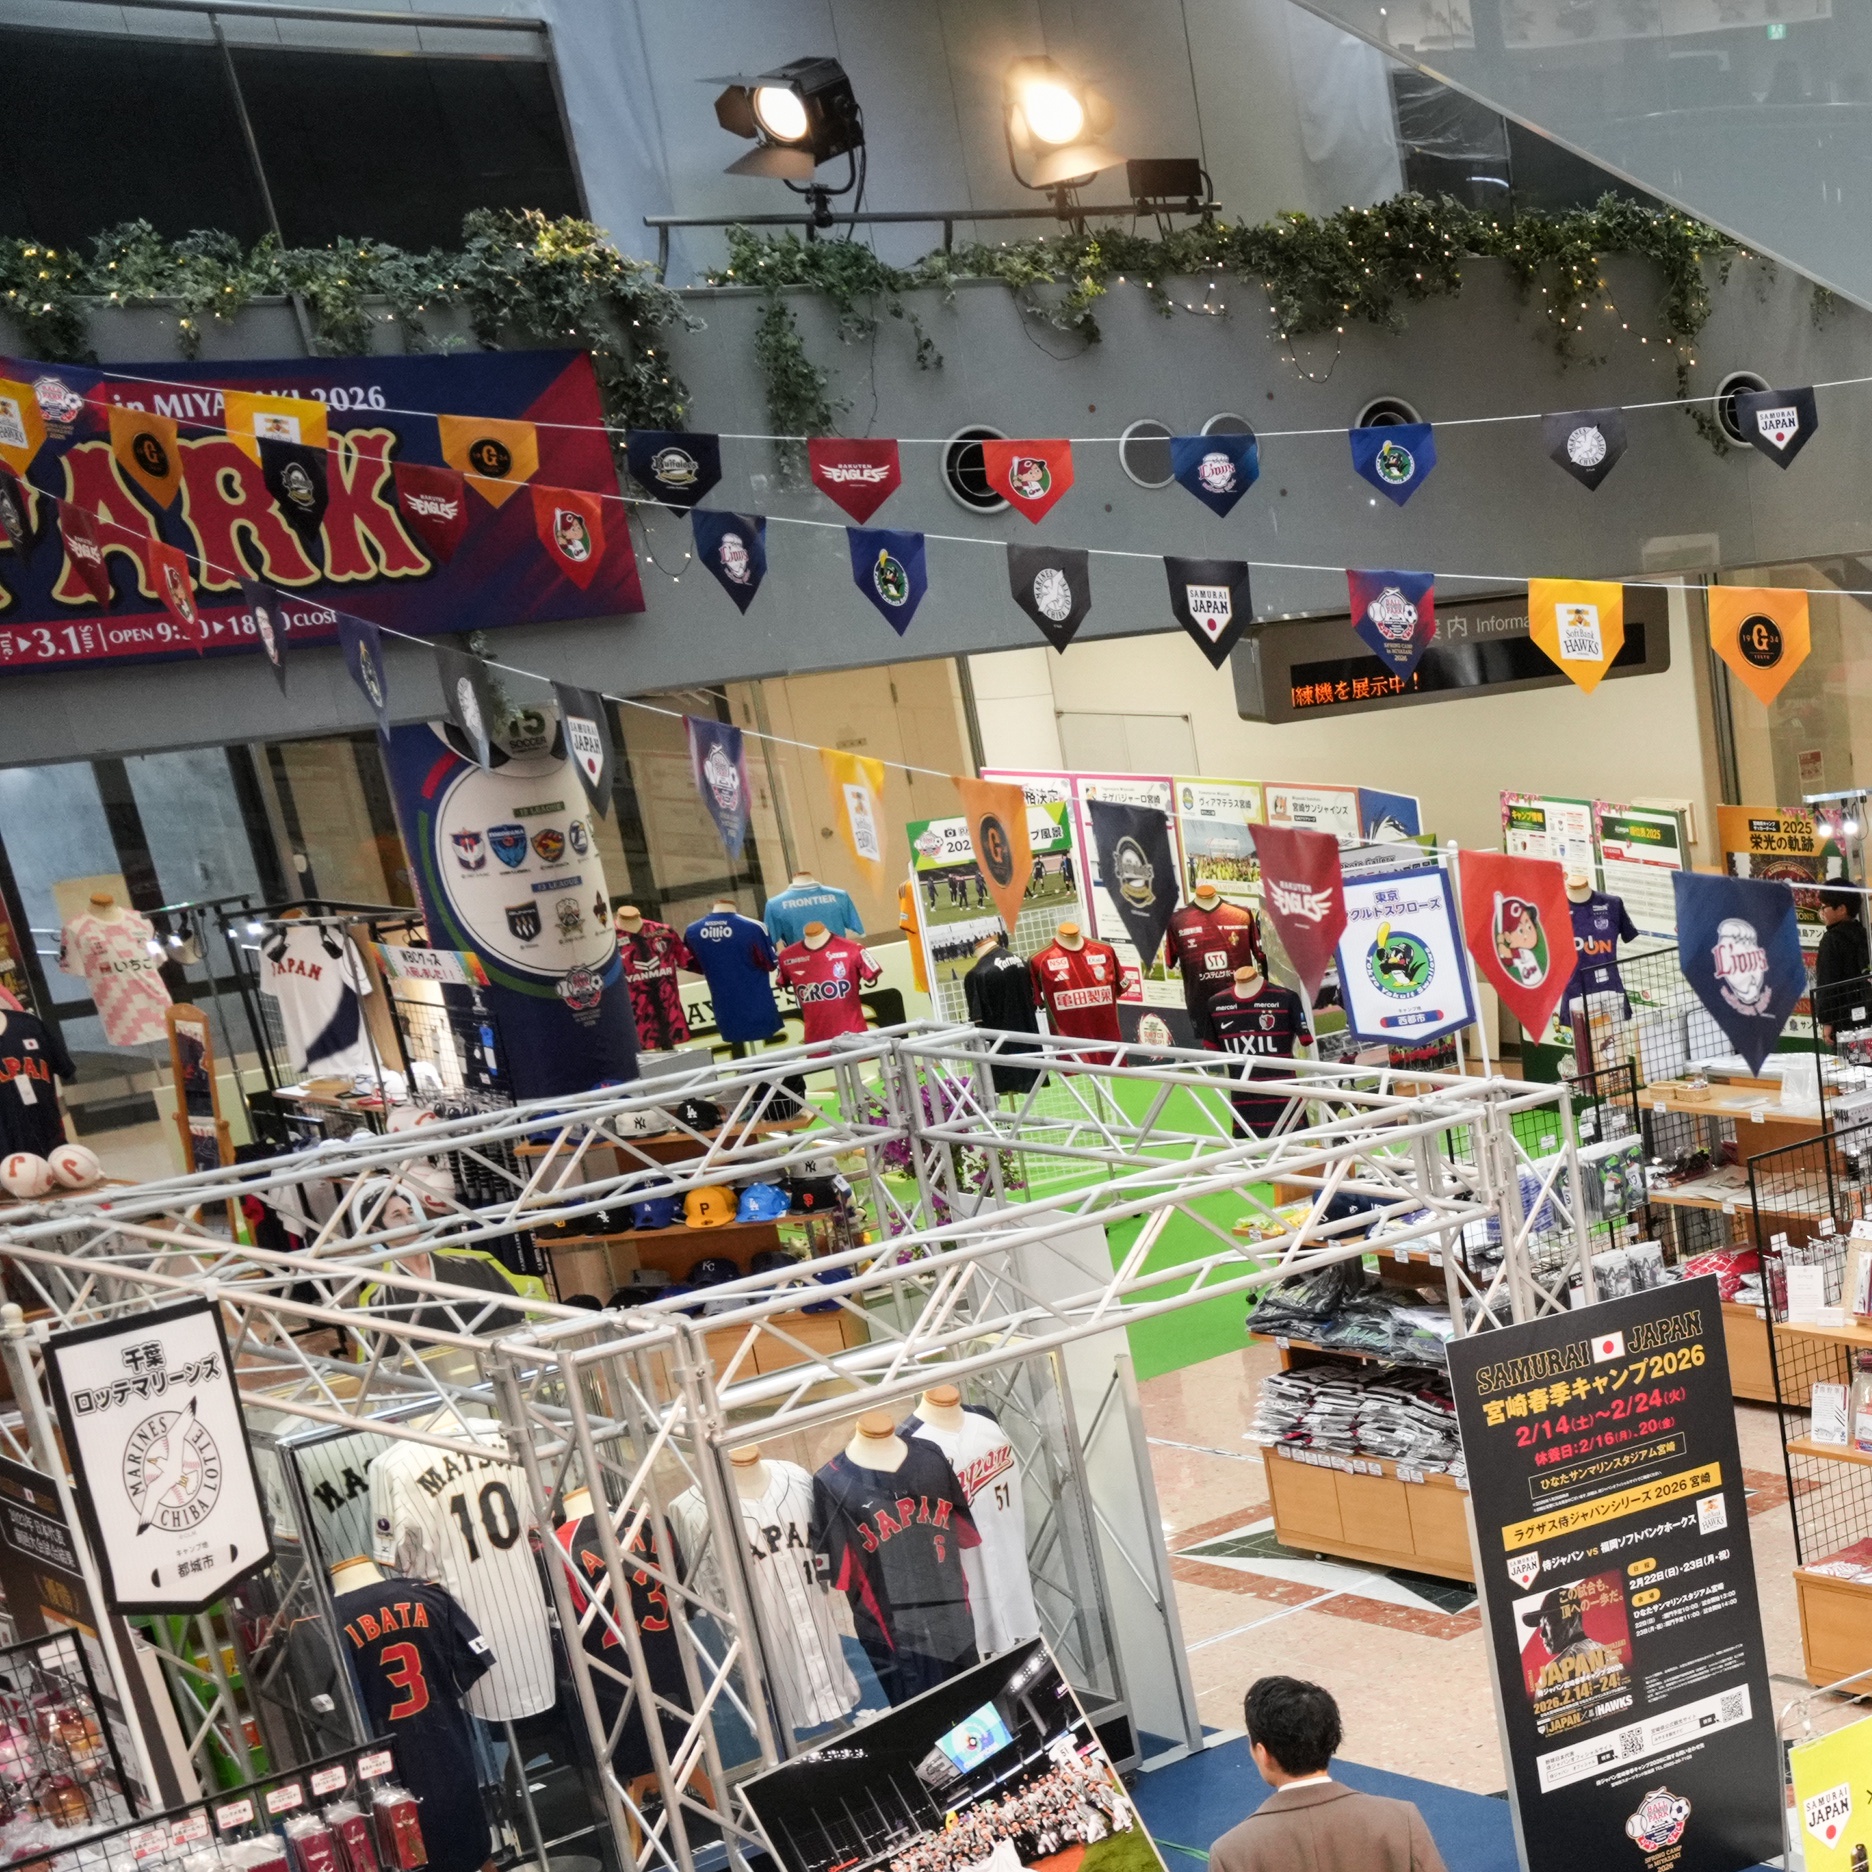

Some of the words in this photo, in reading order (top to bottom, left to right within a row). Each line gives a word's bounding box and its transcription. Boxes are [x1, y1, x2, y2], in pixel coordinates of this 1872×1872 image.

[311, 385, 386, 411] 2026
[1759, 410, 1797, 422] SAMURAI
[1760, 416, 1797, 432] JAPAN
[0, 426, 432, 606] ARK
[1188, 586, 1230, 600] SAMURAI
[1191, 598, 1229, 615] JAPAN
[33, 626, 82, 658] 3.1
[109, 627, 156, 644] OPEN
[1565, 627, 1595, 639] SoftBank
[1563, 639, 1599, 656] HAWKS
[1292, 672, 1420, 709] 練機を展示中！
[573, 734, 601, 754] JAPAN
[1199, 797, 1252, 810] ヴィアマテラス宮崎
[1292, 801, 1349, 816] 宮崎サンシャインズ
[1510, 810, 1545, 824] キャンプ情報
[1783, 820, 1812, 835] 2025
[1750, 833, 1815, 852] 栄光の軌跡
[1279, 880, 1312, 894] RAKUTEN
[1373, 889, 1400, 903] 東京
[782, 894, 837, 909] FRONTIER
[1049, 958, 1068, 969] NSG
[1711, 942, 1770, 978] Lions
[626, 966, 673, 983] YANMAR
[1055, 988, 1113, 1010] 亀田製菓
[1215, 1003, 1238, 1012] mercari
[1254, 1001, 1280, 1009] mercari
[1397, 1013, 1426, 1026] 西都市
[700, 1202, 710, 1215] P
[122, 1341, 166, 1373] 千葉
[1475, 1340, 1592, 1395] SAMURAI
[1627, 1309, 1704, 1354] JAPAN
[73, 1353, 222, 1416] ロッテマリーンズ
[1483, 1344, 1706, 1427] 宮崎春季キャンプ2026
[126, 1415, 168, 1497] MARINES
[1540, 1441, 1677, 1491] ひなたサンマリンスタジアム宮崎
[160, 1499, 211, 1528] CHIBA
[1514, 1489, 1652, 1543] ラグザス侍ジャパンシリーズ
[1654, 1481, 1688, 1499] 2026
[1689, 1471, 1711, 1489] 宮崎
[448, 1481, 521, 1564] 10
[856, 1496, 951, 1554] JAPAN
[1542, 1550, 1585, 1573] 侍ジャパン
[1600, 1513, 1697, 1554] 福岡ソフトバンクホークス
[177, 1555, 214, 1579] 都城市
[1558, 1578, 1611, 1604] この試合も、
[345, 1600, 430, 1648] IBATA
[380, 1641, 430, 1721] 3
[1534, 1651, 1607, 1690] JAPAN
[1646, 1800, 1668, 1812] BALL
[1803, 1782, 1849, 1817] SAMURAI
[1647, 1810, 1670, 1823] PARK
[1805, 1798, 1850, 1830] JAPAN
